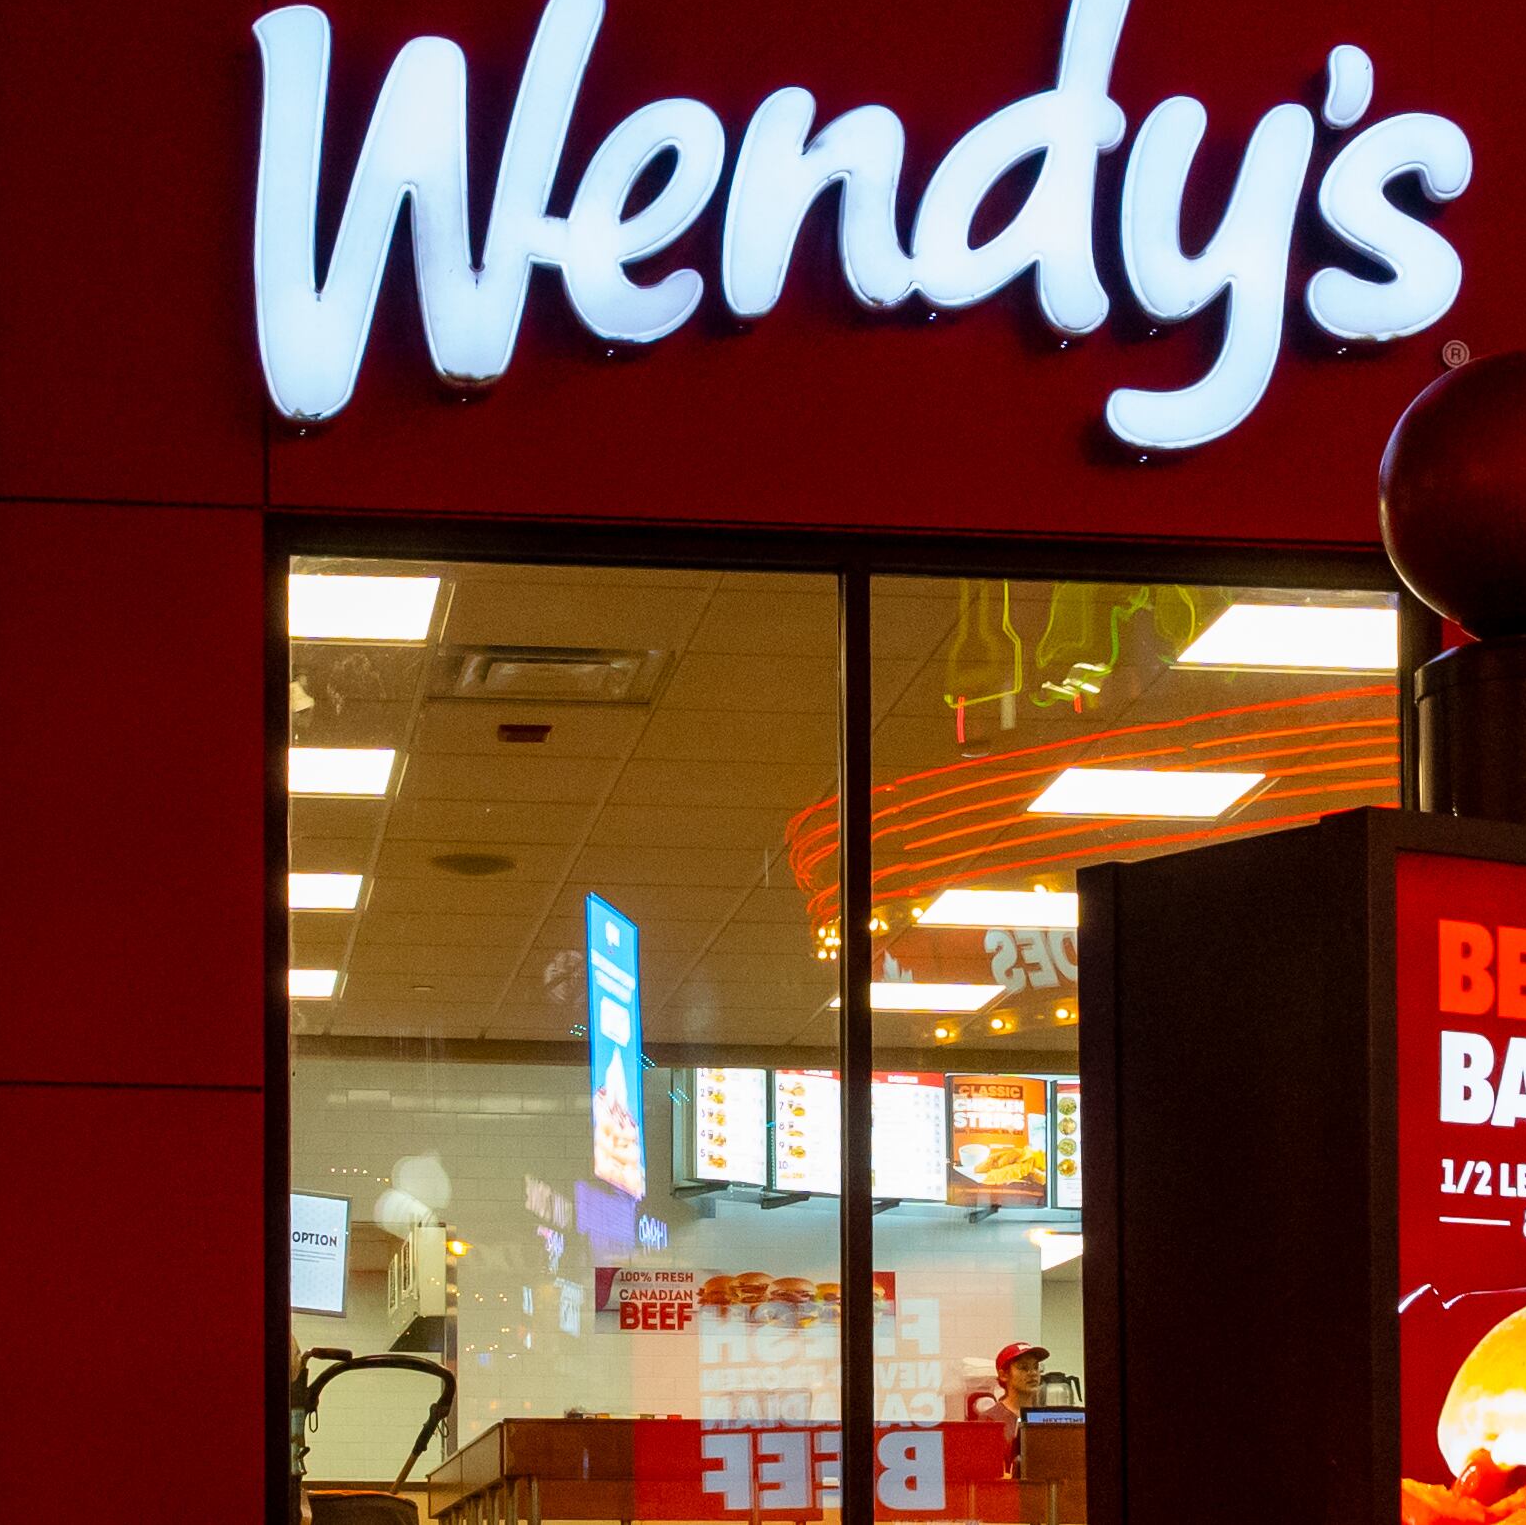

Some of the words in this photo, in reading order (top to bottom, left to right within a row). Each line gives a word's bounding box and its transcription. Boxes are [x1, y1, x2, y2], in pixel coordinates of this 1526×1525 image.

[958, 1085, 1022, 1099] CLASSIC
[1440, 1158, 1493, 1196] 1/2
[292, 1230, 338, 1247] OPTION
[619, 1271, 652, 1283] 100%
[655, 1272, 694, 1283] FRESH
[619, 1289, 693, 1301] CANADIAN
[620, 1302, 694, 1331] BEEF
